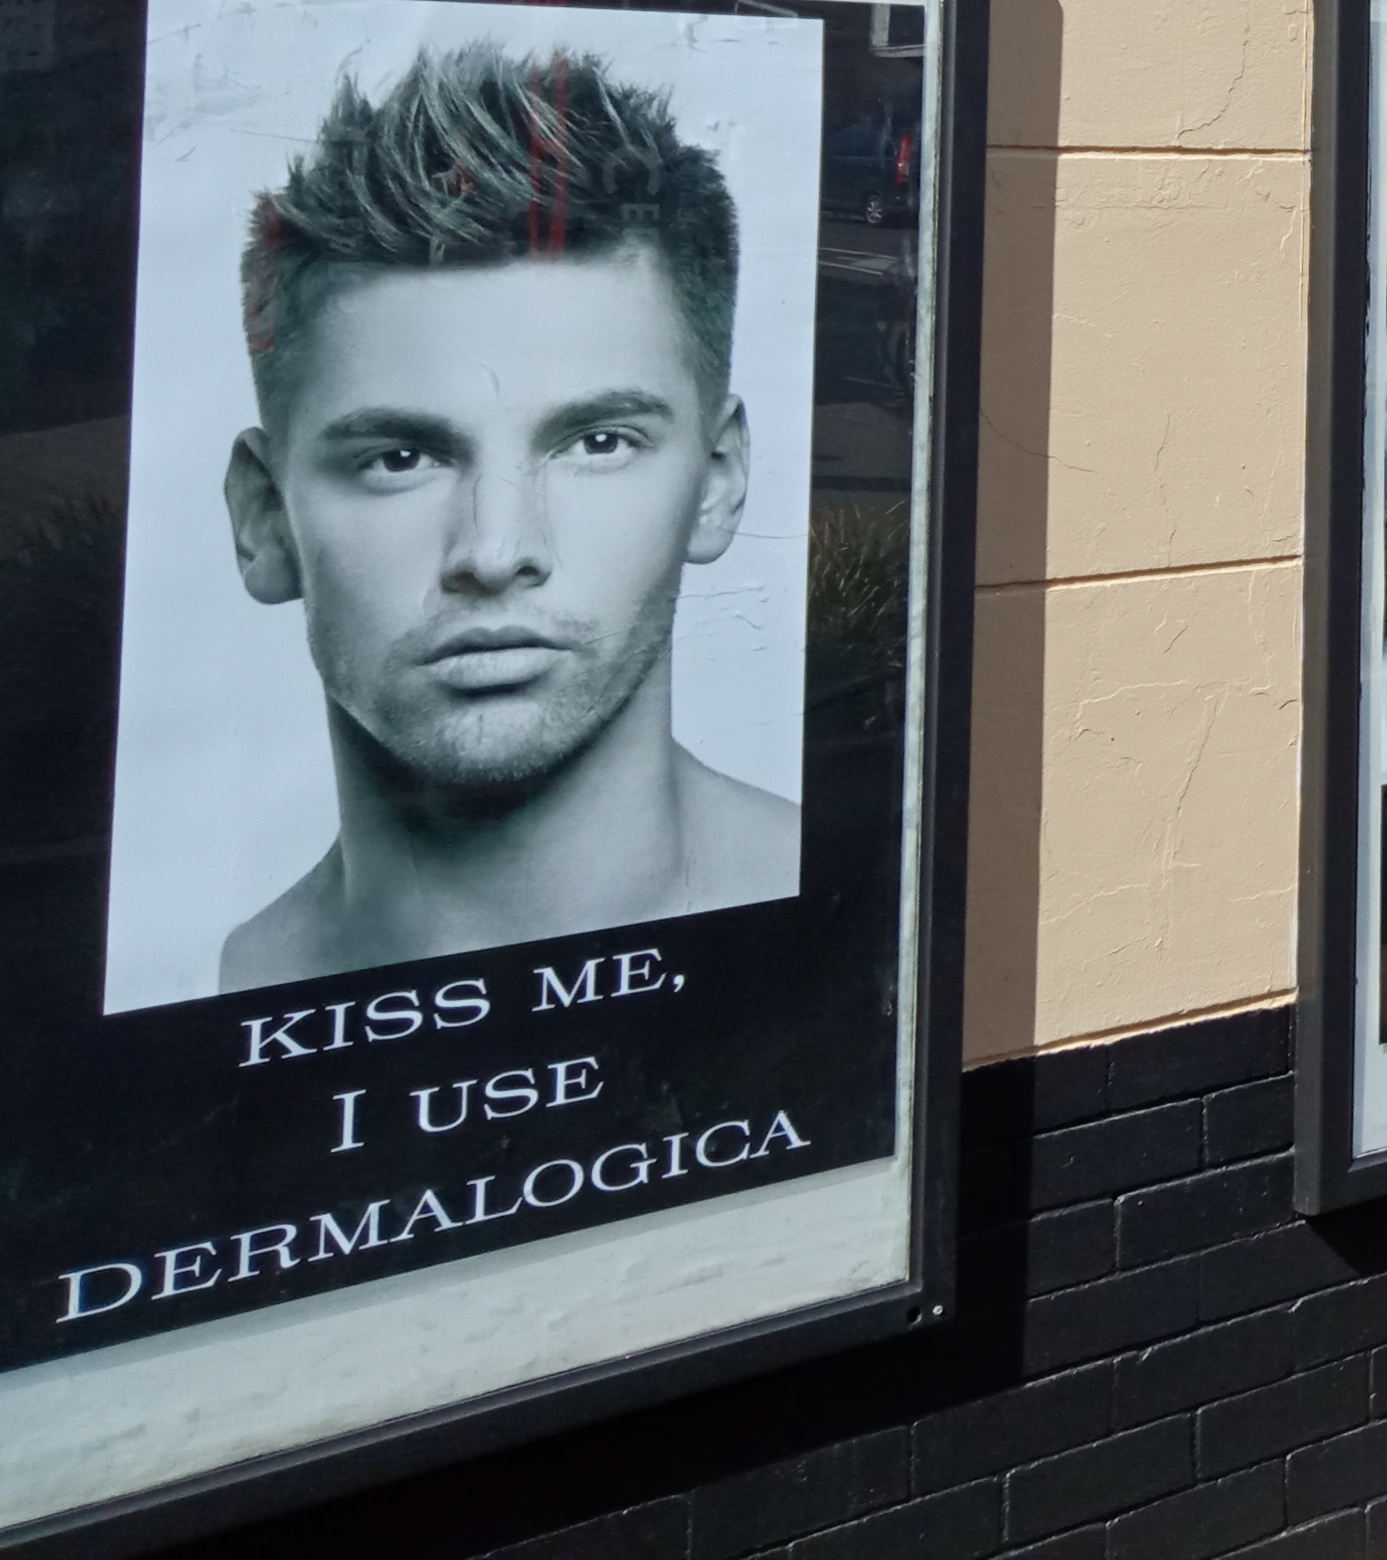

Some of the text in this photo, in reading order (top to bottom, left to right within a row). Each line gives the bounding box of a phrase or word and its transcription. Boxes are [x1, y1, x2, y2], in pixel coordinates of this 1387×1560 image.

[239, 947, 687, 1067] KISS ME,
[330, 1056, 605, 1153] I USE
[57, 1110, 812, 1323] DERMALOGICA
